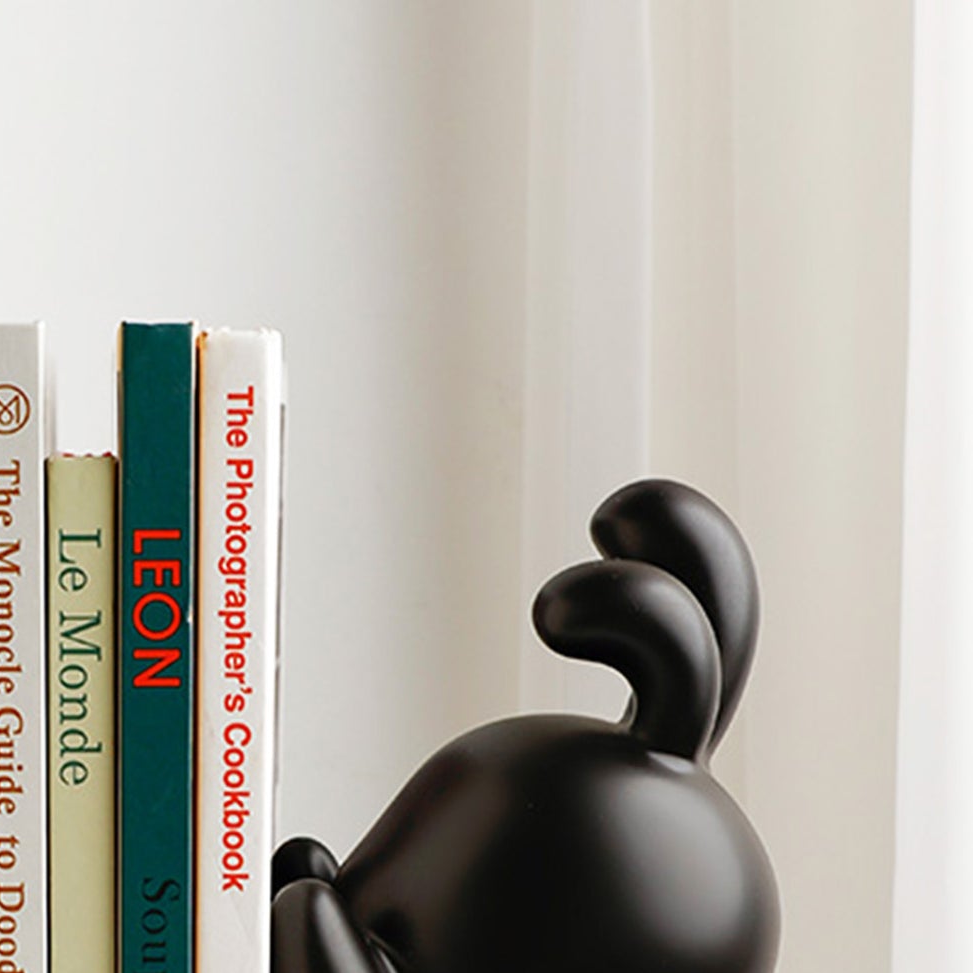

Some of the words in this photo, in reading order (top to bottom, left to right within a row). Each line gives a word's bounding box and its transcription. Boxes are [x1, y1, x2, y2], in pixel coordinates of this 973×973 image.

[226, 386, 253, 447] The
[58, 529, 102, 592] Le
[133, 530, 180, 686] LEON
[218, 459, 253, 712] Photographer’s
[58, 610, 102, 786] Monde
[222, 723, 251, 891] Cookbook
